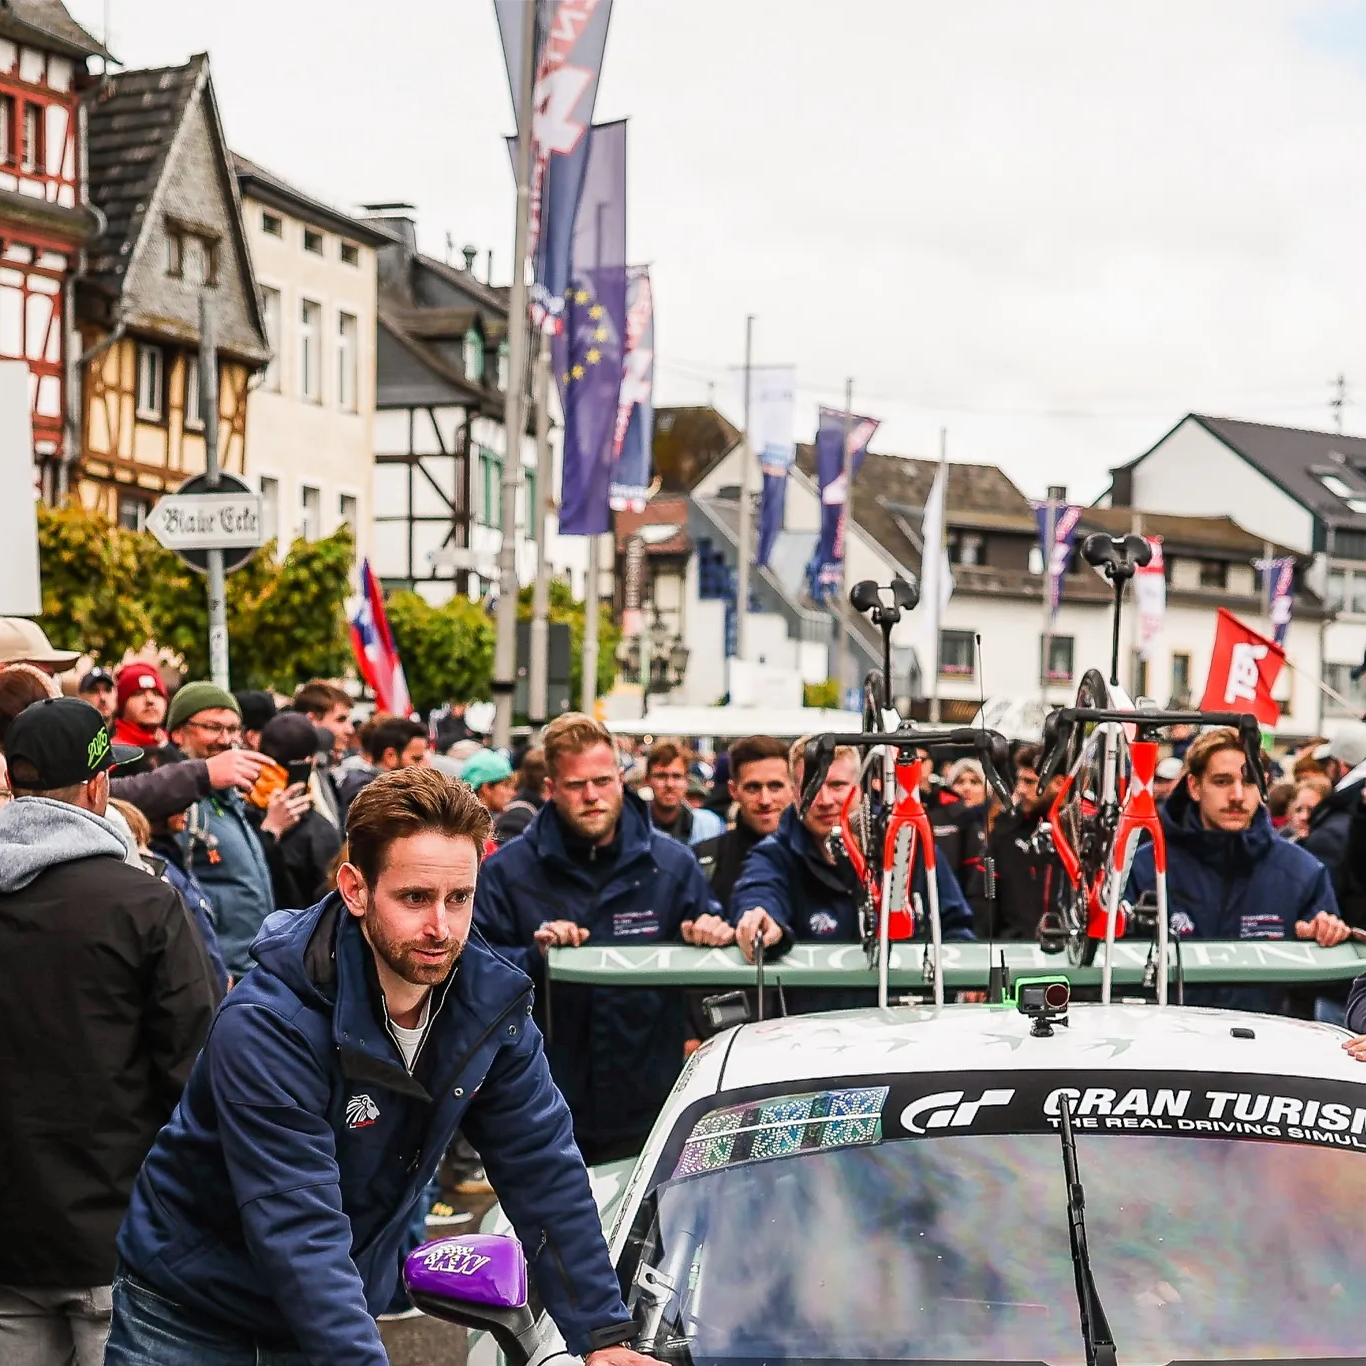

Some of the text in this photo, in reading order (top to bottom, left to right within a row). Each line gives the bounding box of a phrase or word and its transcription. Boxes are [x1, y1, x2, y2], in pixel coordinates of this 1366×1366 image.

[1043, 1087, 1192, 1118] GRAN
[1047, 1117, 1099, 1129] THE
[1106, 1117, 1172, 1130] REAL
[1178, 1118, 1283, 1137] DRIVING
